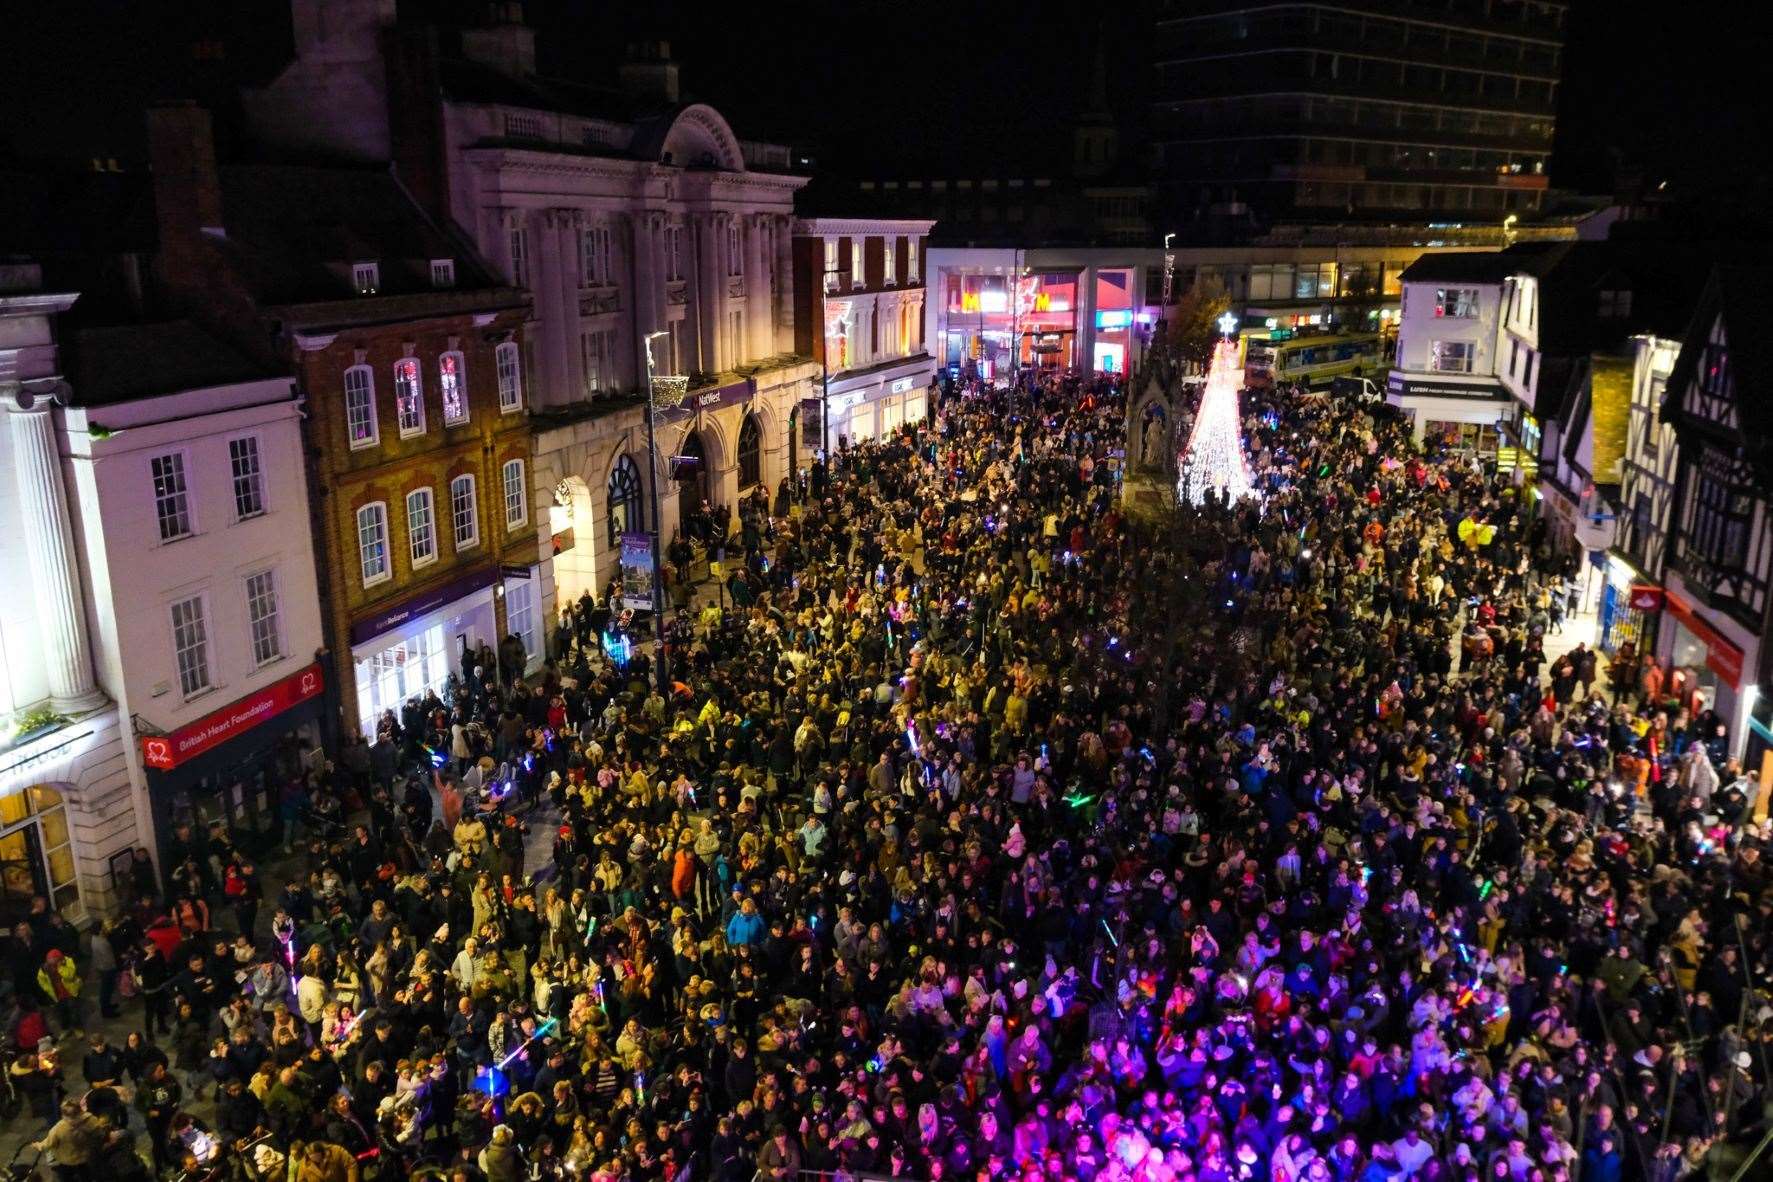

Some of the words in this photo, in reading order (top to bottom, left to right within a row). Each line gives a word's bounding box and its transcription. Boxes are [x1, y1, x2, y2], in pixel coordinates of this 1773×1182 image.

[1410, 386, 1429, 394] LUSH
[698, 391, 721, 407] NatWest
[179, 732, 208, 752] British
[207, 719, 231, 741] Heart
[231, 699, 274, 728] Foundation
